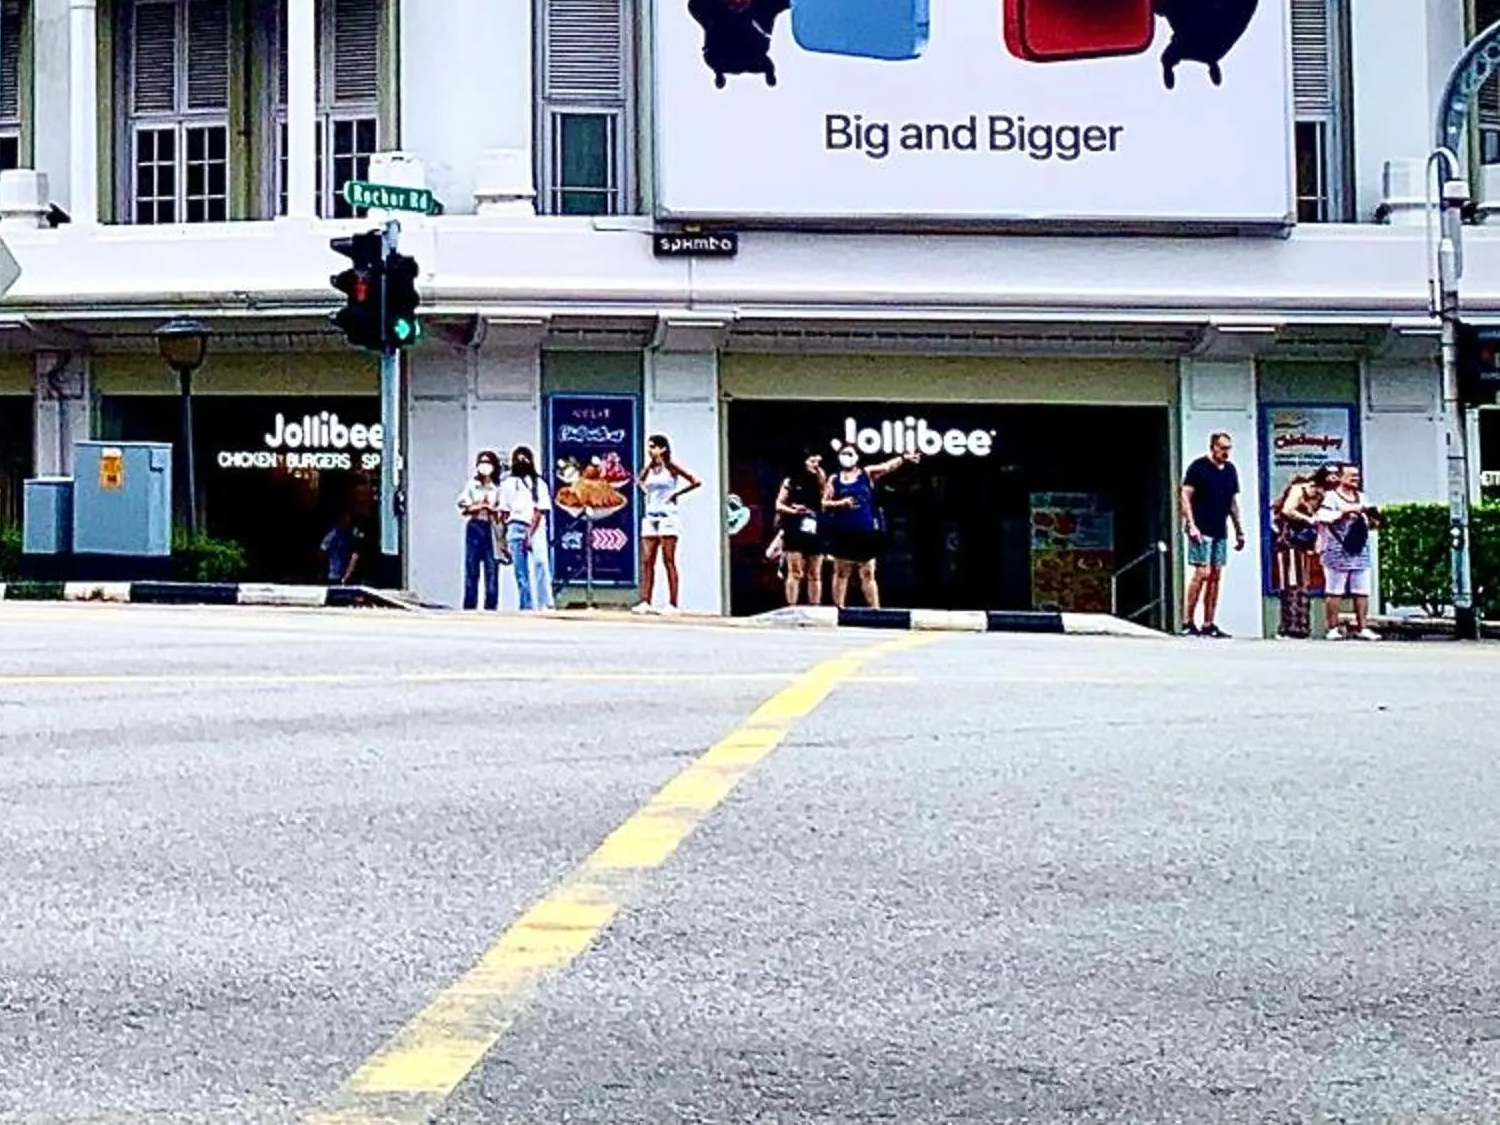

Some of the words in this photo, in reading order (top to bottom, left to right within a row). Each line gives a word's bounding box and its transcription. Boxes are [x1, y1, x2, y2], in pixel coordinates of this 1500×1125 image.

[825, 114, 890, 160] Big
[899, 115, 978, 151] and
[988, 115, 1125, 161] Bigger
[409, 190, 428, 210] Rd
[264, 410, 383, 449] Jollibee
[217, 451, 277, 468] CHICKEN
[285, 452, 352, 470] BURGERS
